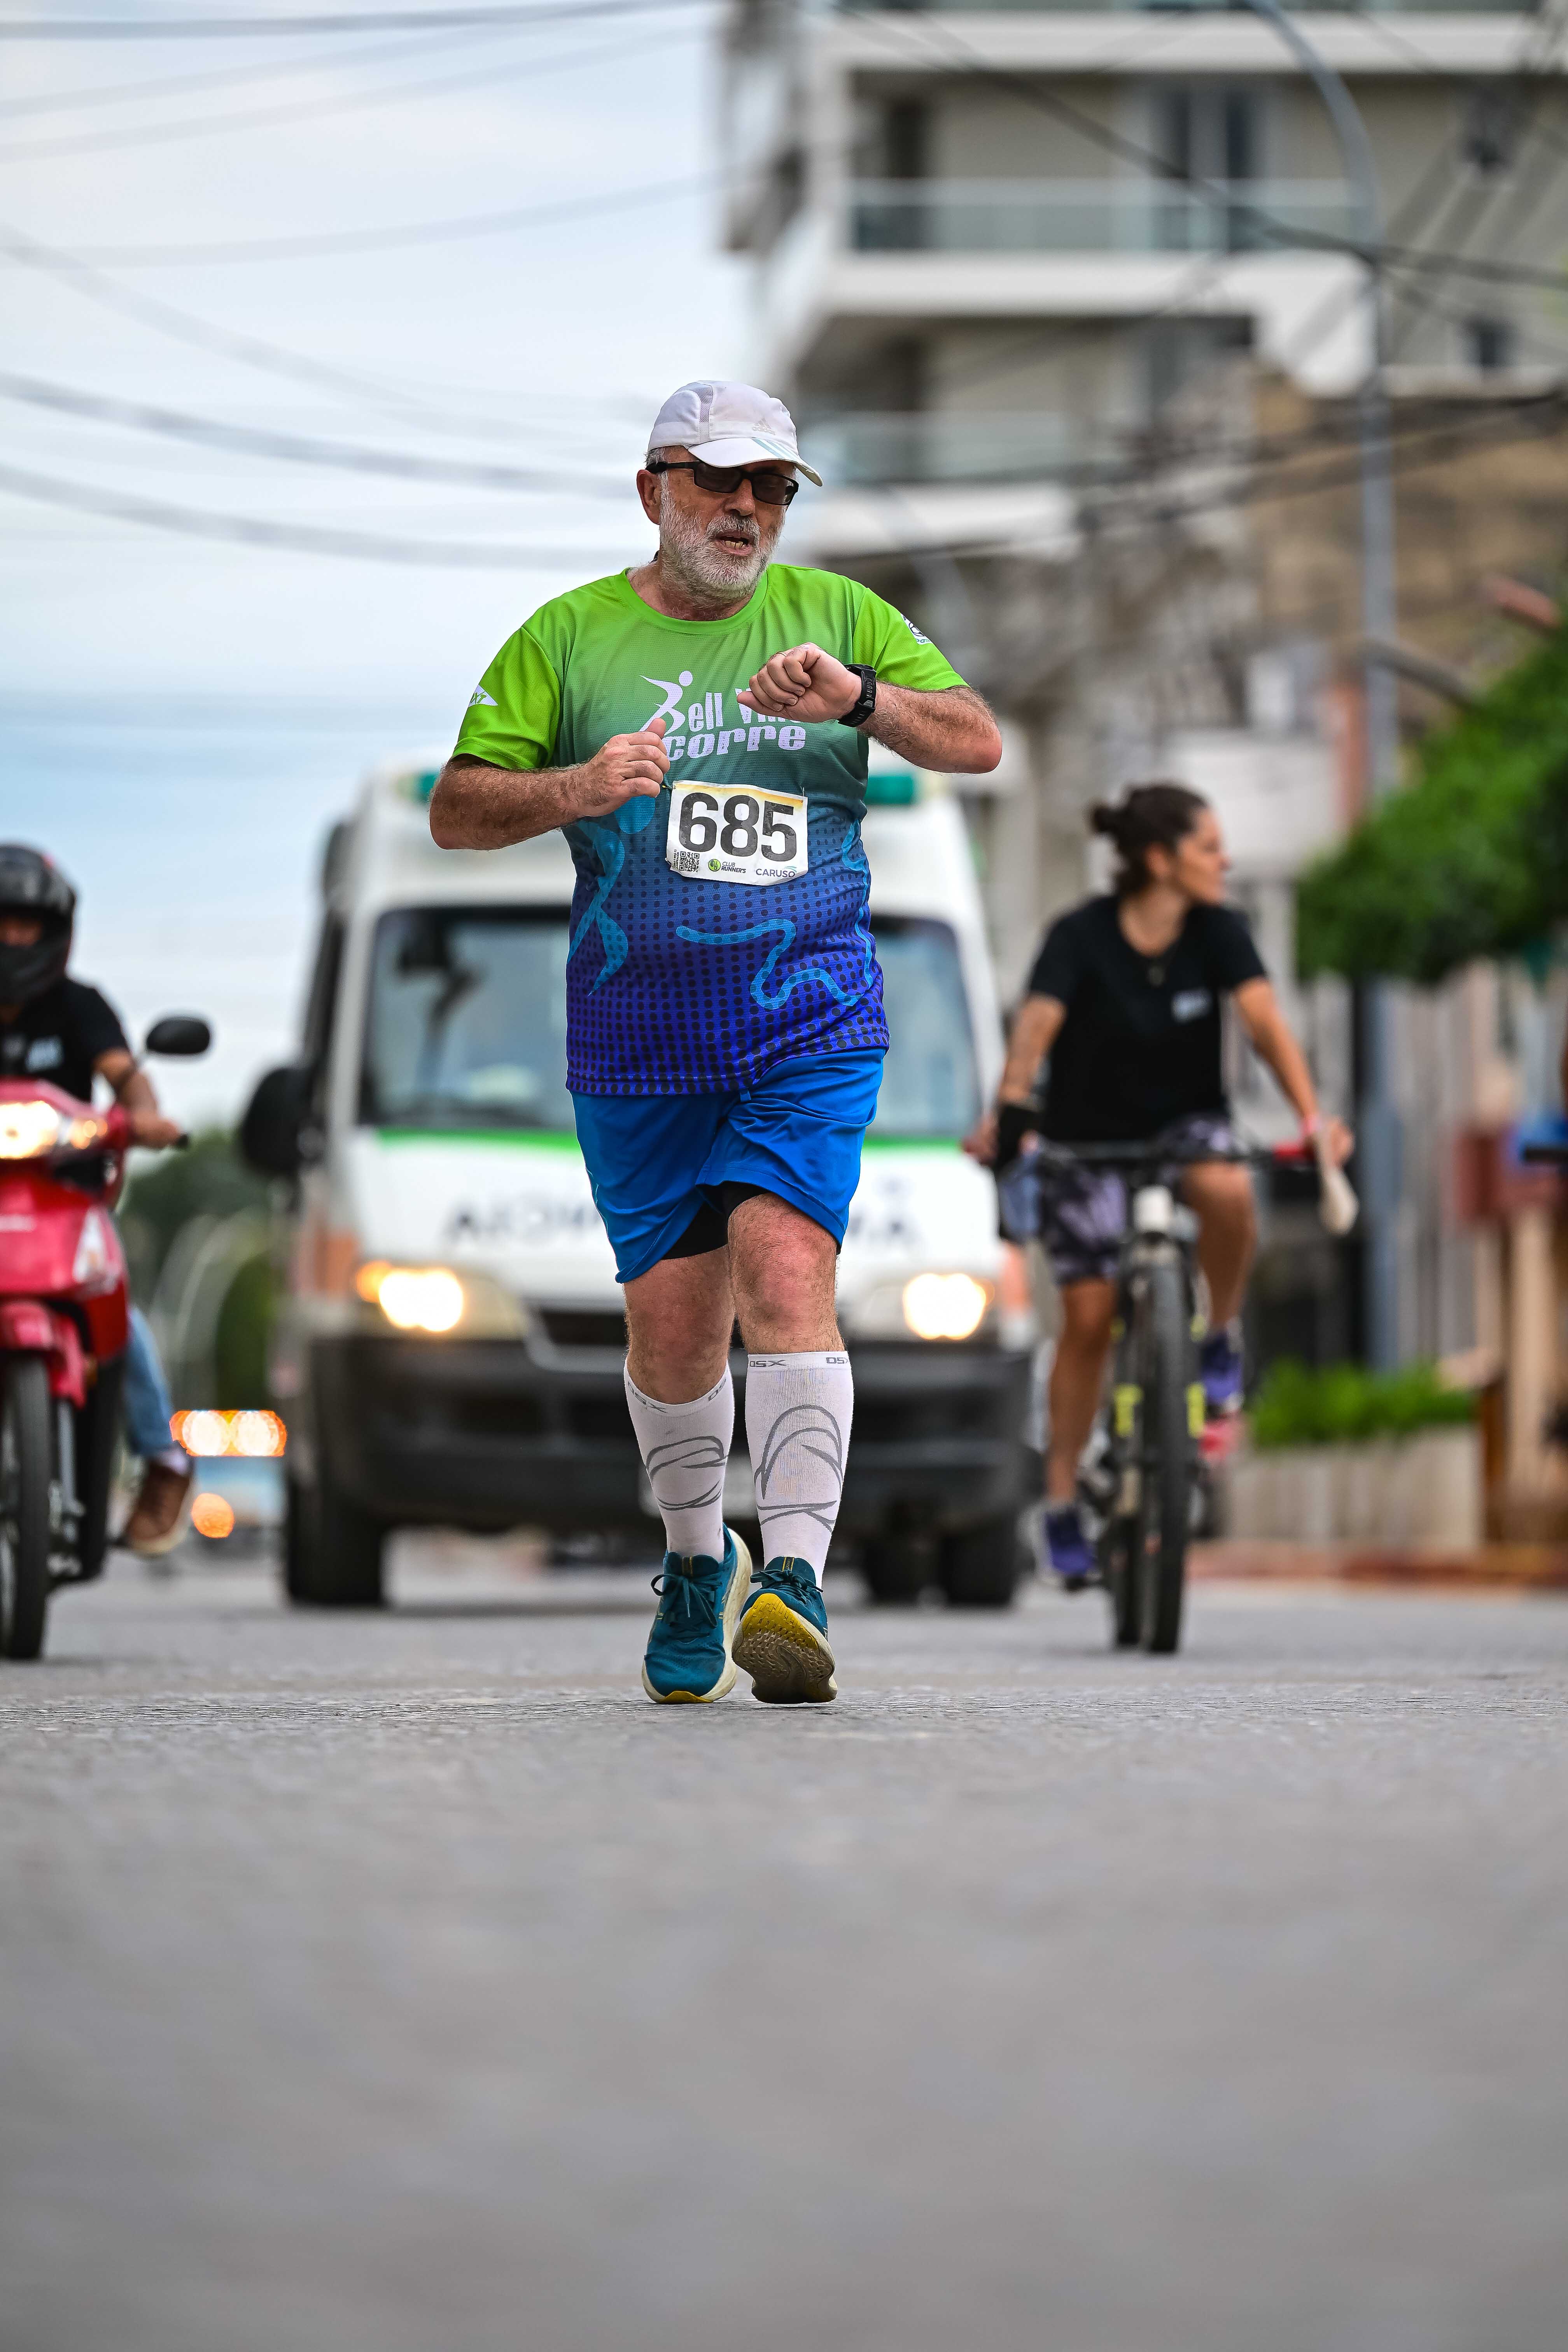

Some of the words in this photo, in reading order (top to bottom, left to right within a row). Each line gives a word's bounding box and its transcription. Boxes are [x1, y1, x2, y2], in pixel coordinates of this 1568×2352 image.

[663, 725, 806, 761] corre
[679, 792, 796, 861] 685
[756, 868, 796, 878] CARUSO
